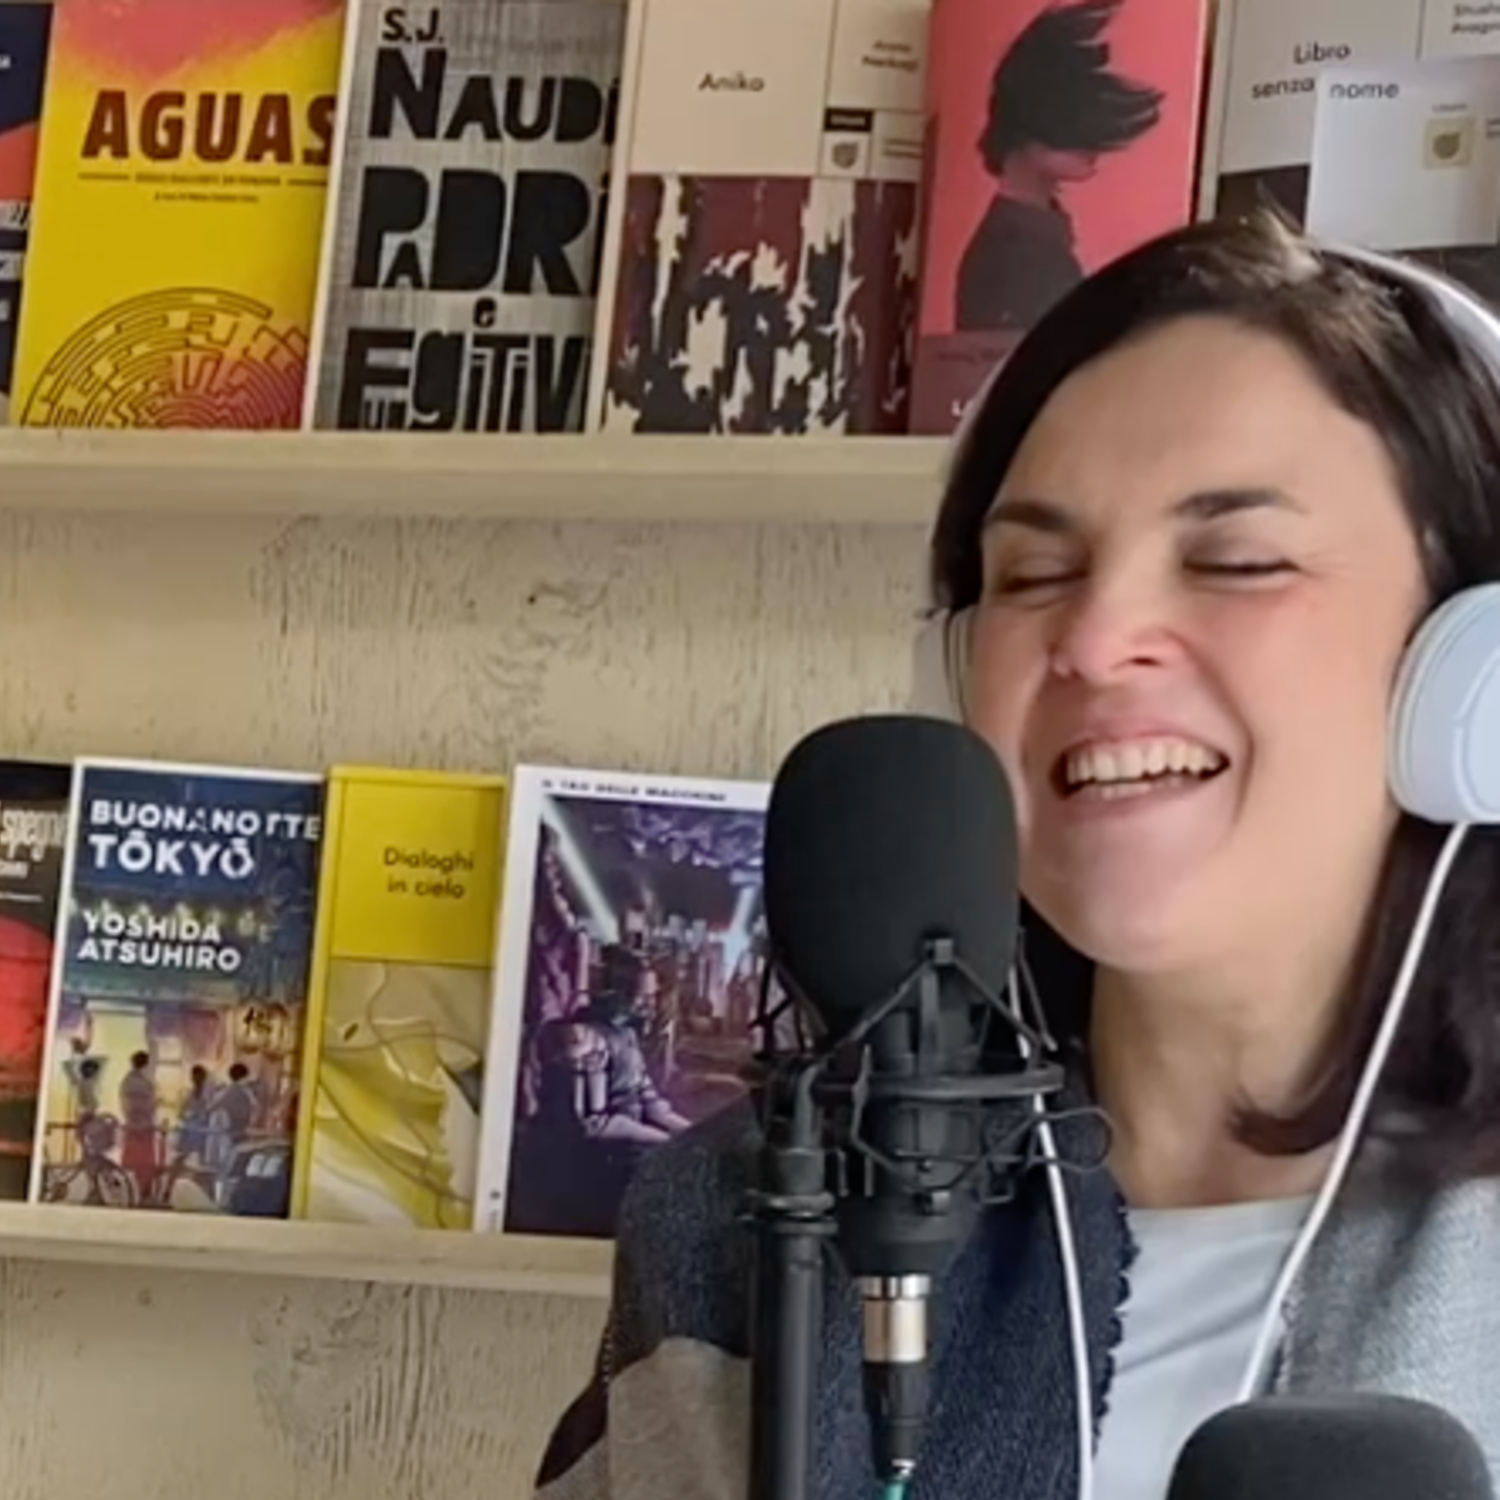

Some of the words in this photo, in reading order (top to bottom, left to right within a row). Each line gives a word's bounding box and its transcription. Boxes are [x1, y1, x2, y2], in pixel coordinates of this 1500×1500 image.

[382, 8, 444, 42] S.J.
[1293, 42, 1351, 65] Libro
[699, 72, 764, 93] Aniko
[1252, 77, 1315, 99] senza
[1329, 82, 1399, 99] nome
[81, 89, 337, 166] AGUAS
[473, 297, 497, 327] e
[384, 846, 475, 875] Dialoghi
[387, 877, 408, 895] in
[415, 877, 466, 900] cielo
[82, 908, 222, 943] YOSHIDA
[77, 937, 241, 972] ATSUHIRO
